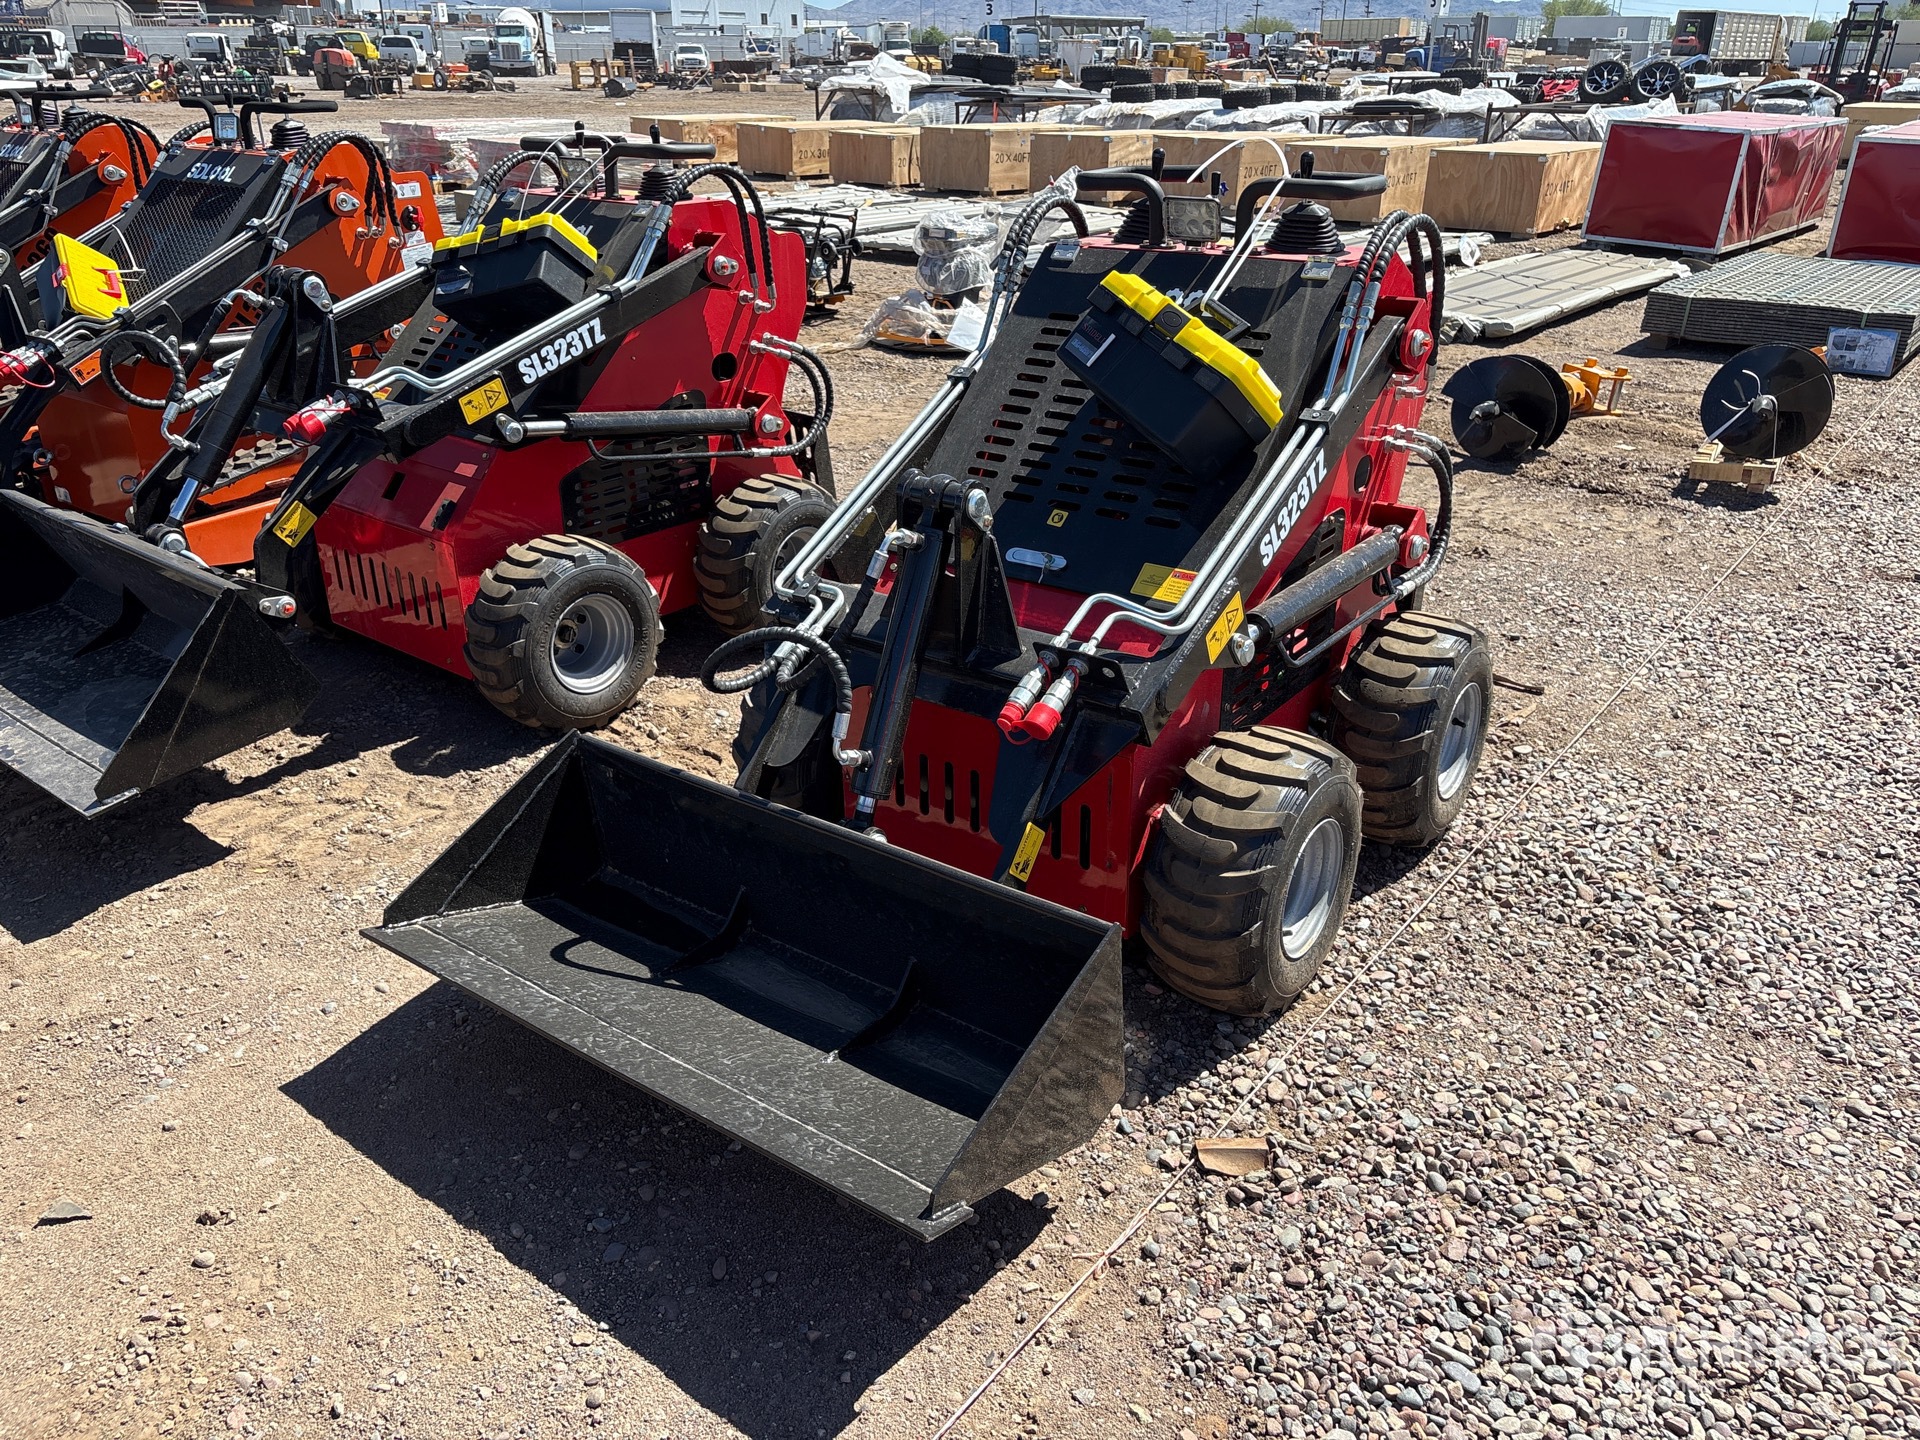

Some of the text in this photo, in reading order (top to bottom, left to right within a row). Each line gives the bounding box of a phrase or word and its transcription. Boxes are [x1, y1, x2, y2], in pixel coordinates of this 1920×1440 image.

[985, 3, 993, 16] 3
[518, 316, 607, 385] SL323TZ
[1259, 447, 1328, 568] SL323TZ
